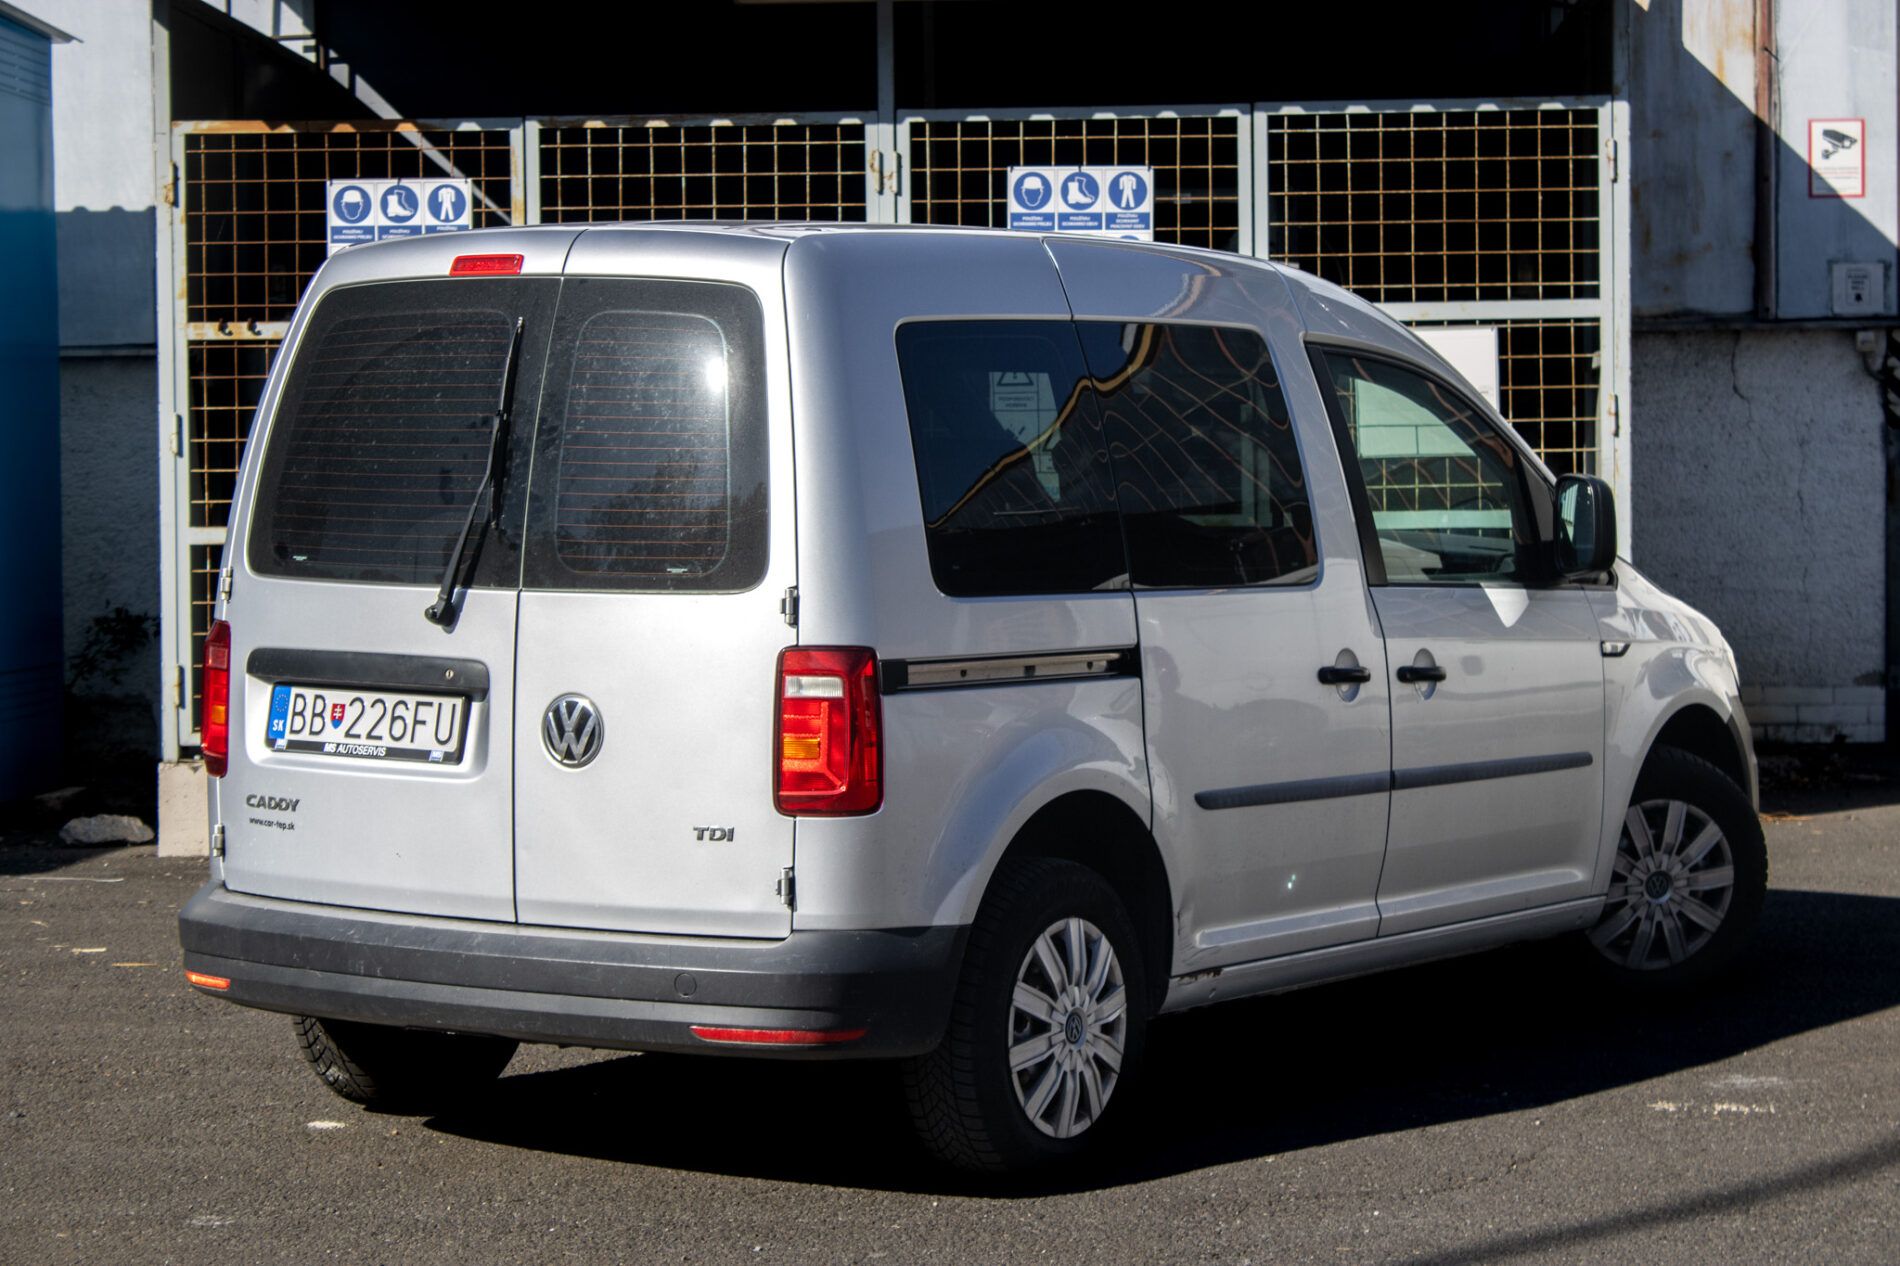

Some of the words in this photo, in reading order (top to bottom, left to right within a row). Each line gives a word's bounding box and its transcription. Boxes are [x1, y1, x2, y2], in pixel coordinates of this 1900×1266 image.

[272, 719, 285, 732] SK
[289, 693, 326, 736] BB
[344, 697, 457, 746] 226FU
[324, 743, 337, 754] MS
[337, 744, 387, 758] AUTOSERVIS
[246, 793, 300, 813] CADDY
[693, 826, 735, 842] TDI
